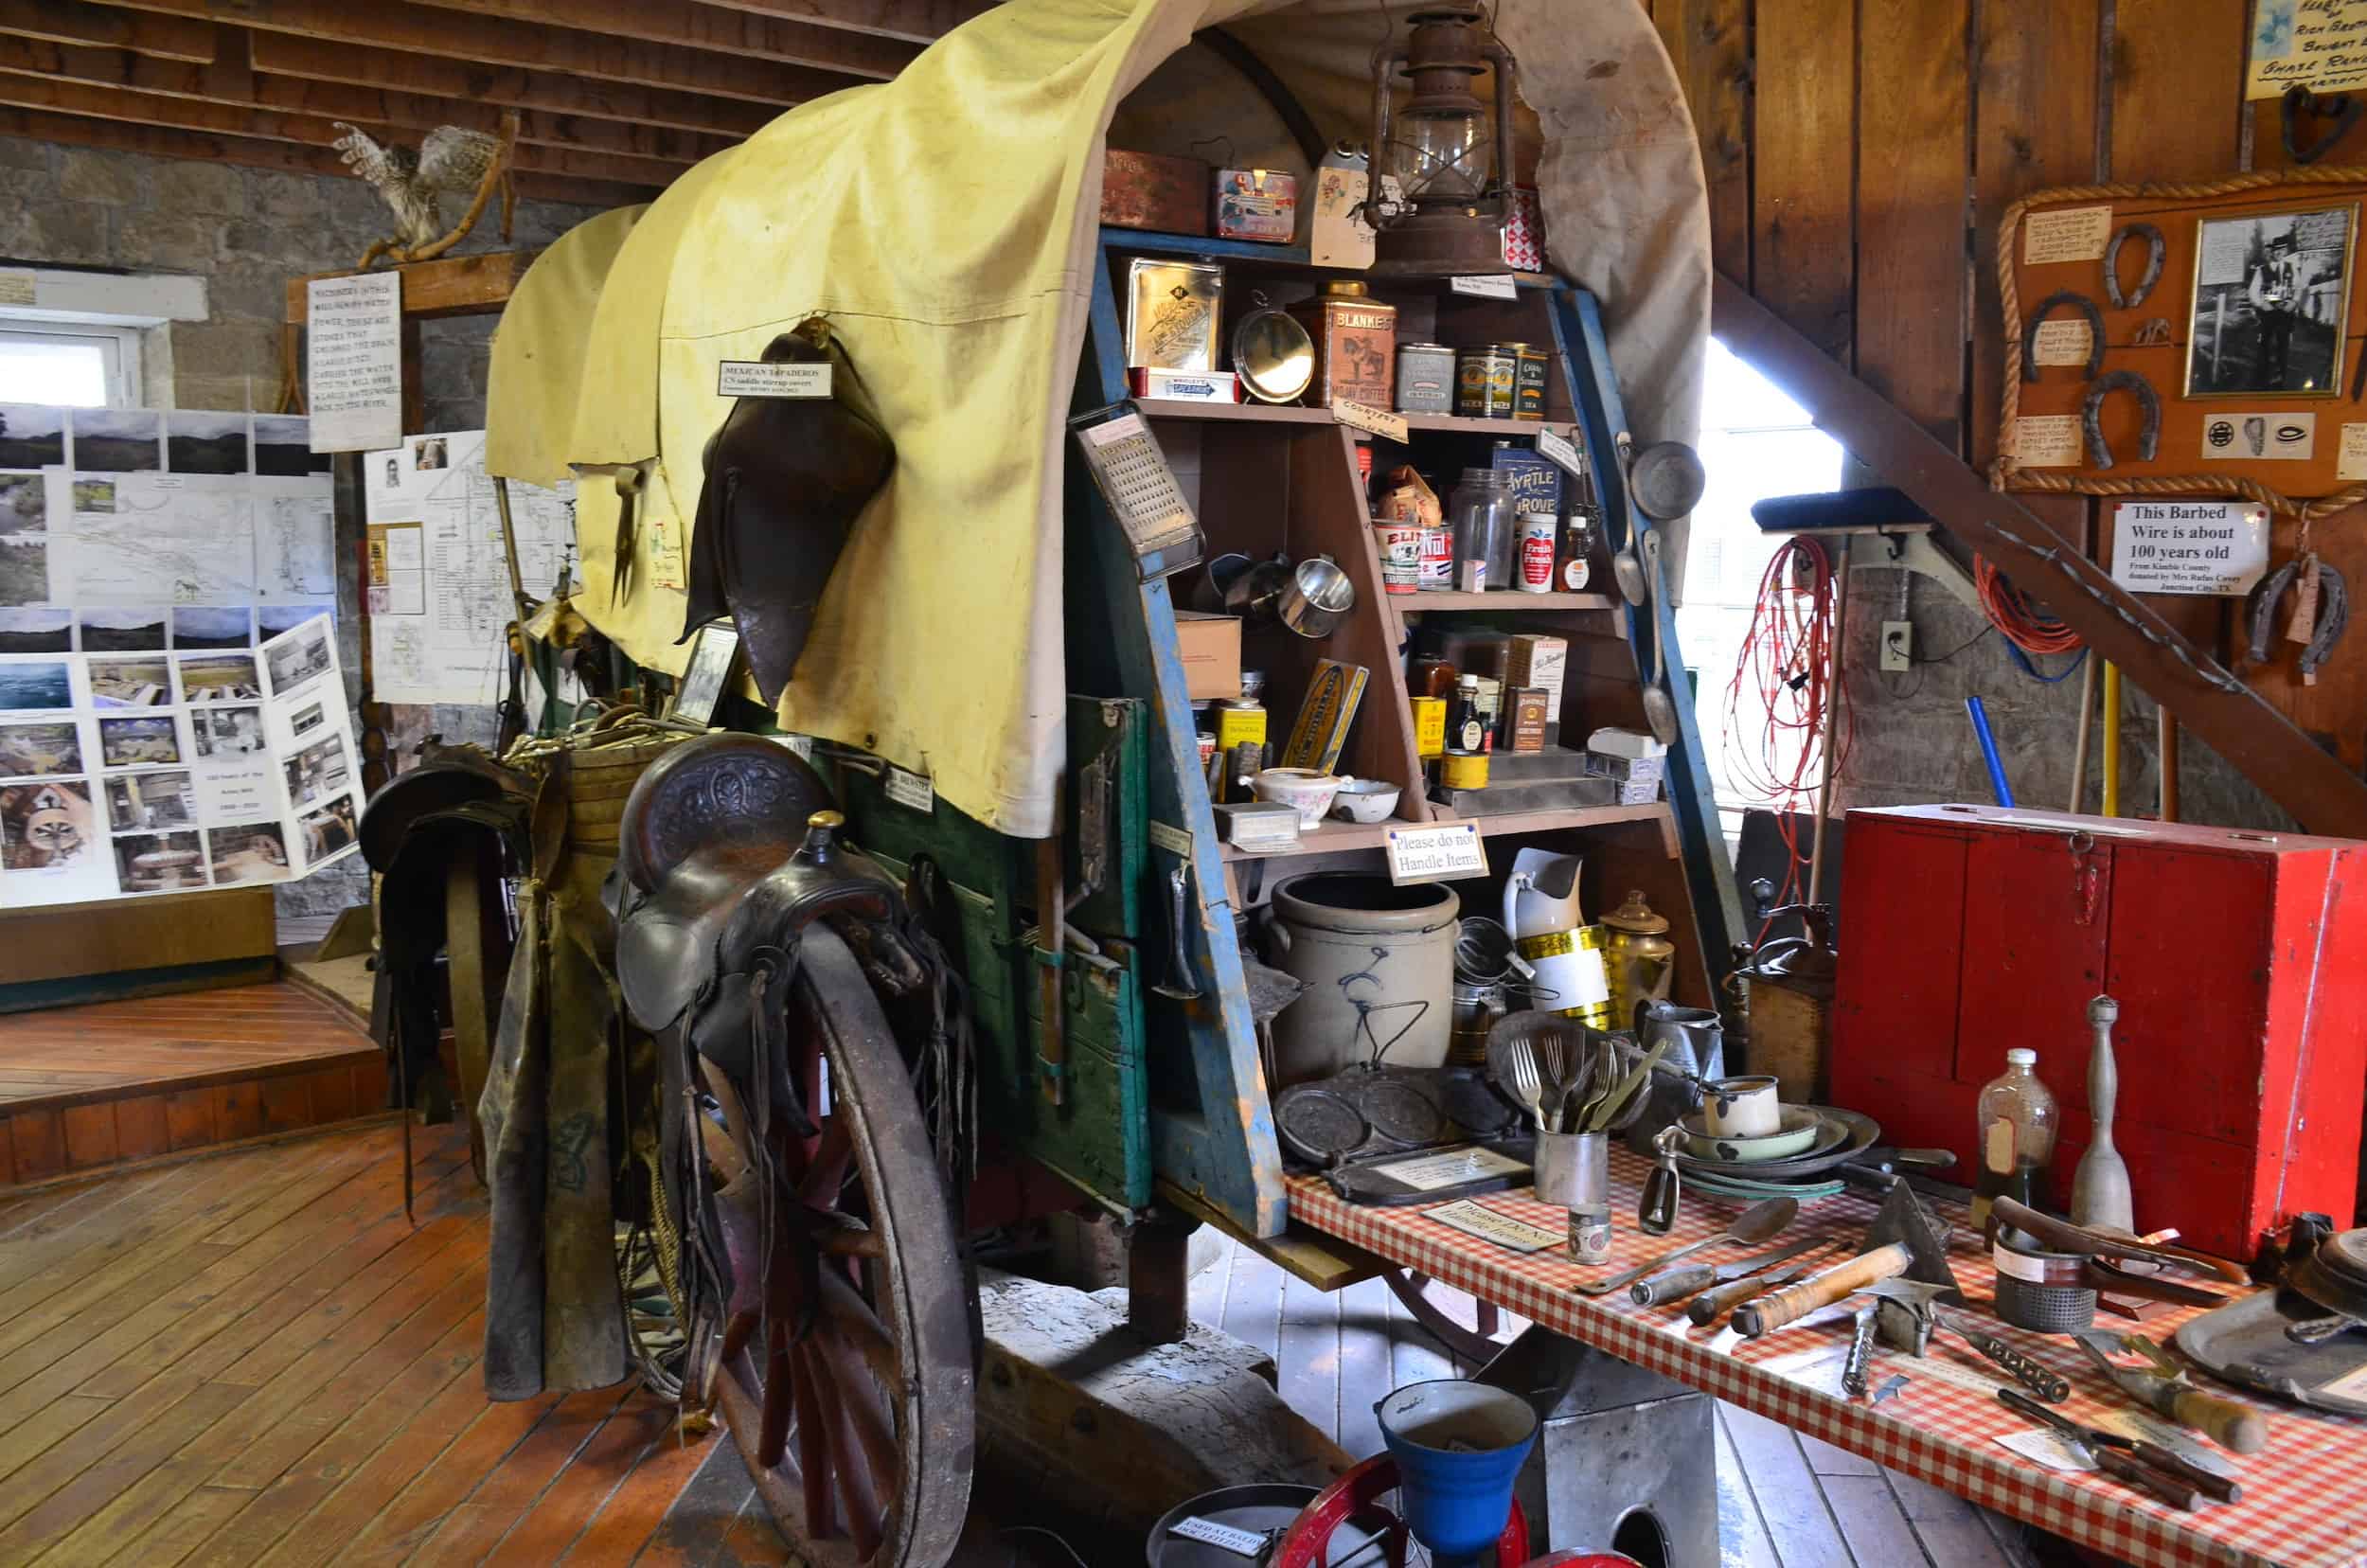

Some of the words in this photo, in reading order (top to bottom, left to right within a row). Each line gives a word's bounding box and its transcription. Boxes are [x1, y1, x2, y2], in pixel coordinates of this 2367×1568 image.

[2133, 505, 2165, 520] This
[2169, 505, 2228, 520] Barbed
[2131, 525, 2169, 540] Wire
[2172, 525, 2185, 540] is
[2188, 525, 2235, 540] about
[2129, 543, 2156, 559] 100
[2159, 547, 2201, 561] years
[2204, 544, 2231, 560] old
[1396, 835, 1435, 850] Please
[1438, 832, 1454, 847] do
[1455, 833, 1475, 846] not
[1397, 853, 1443, 871] Handle
[1446, 852, 1480, 867] Items
[1456, 1203, 1504, 1223] Please
